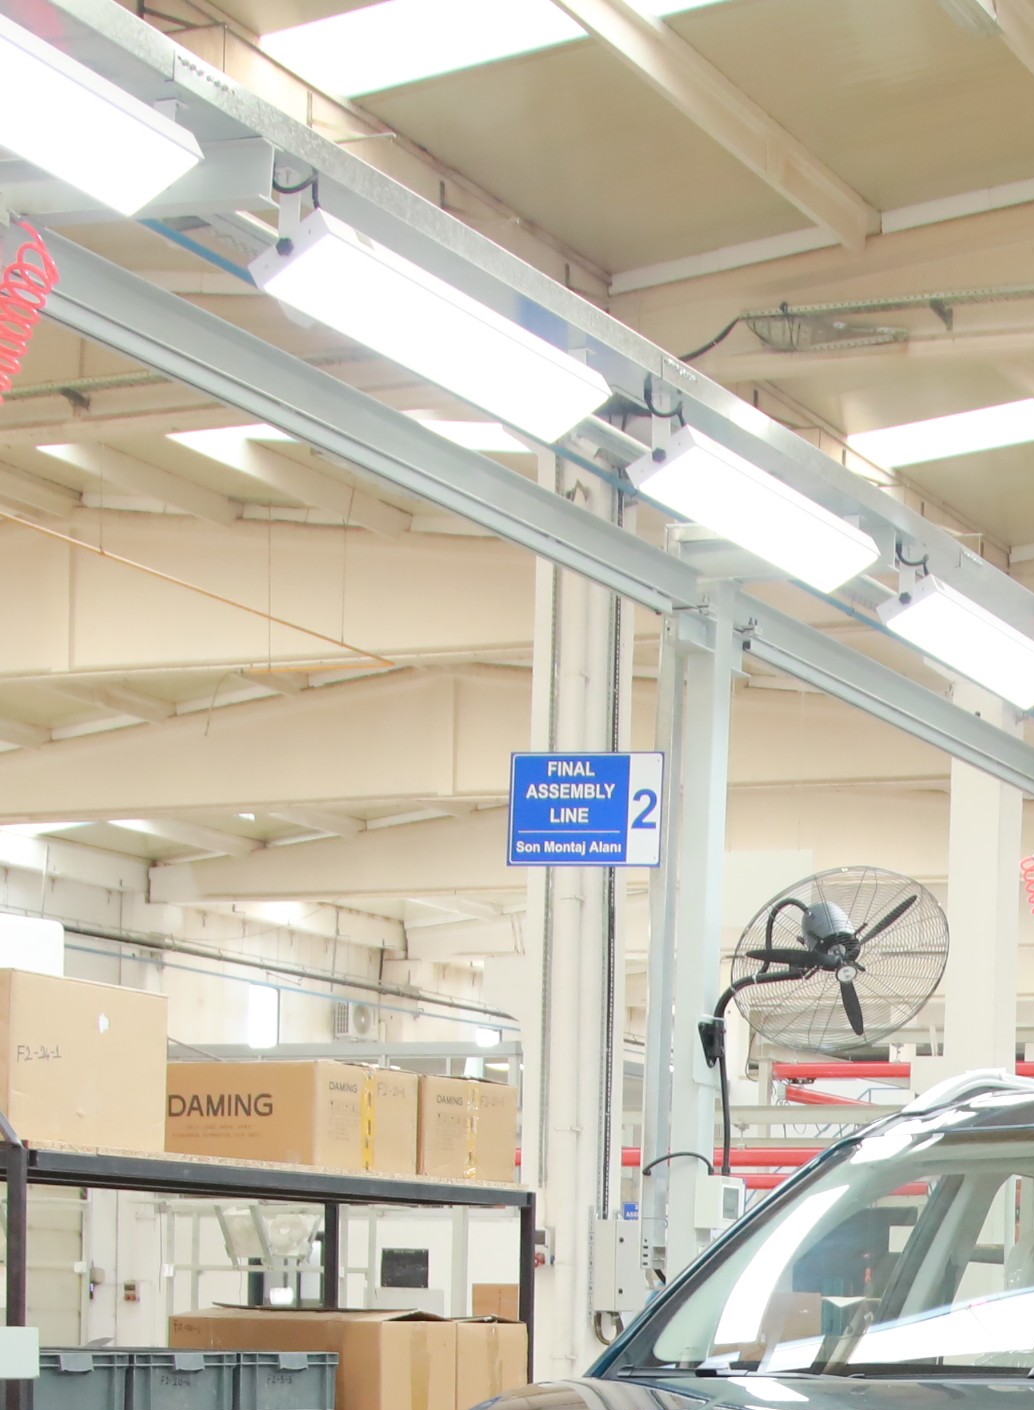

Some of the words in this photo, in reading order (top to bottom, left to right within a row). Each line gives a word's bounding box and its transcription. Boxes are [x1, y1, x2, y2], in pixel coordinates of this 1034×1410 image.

[547, 761, 595, 776] FINAL
[526, 783, 616, 799] ASSEMBLY
[550, 807, 589, 823] LINE
[631, 788, 658, 829] 2
[516, 841, 541, 853] Son
[544, 841, 586, 856] Montaj
[589, 841, 622, 853] Alanı
[328, 1081, 358, 1094] DAMING
[167, 1093, 273, 1117] DAMING
[436, 1094, 464, 1106] DAMING
